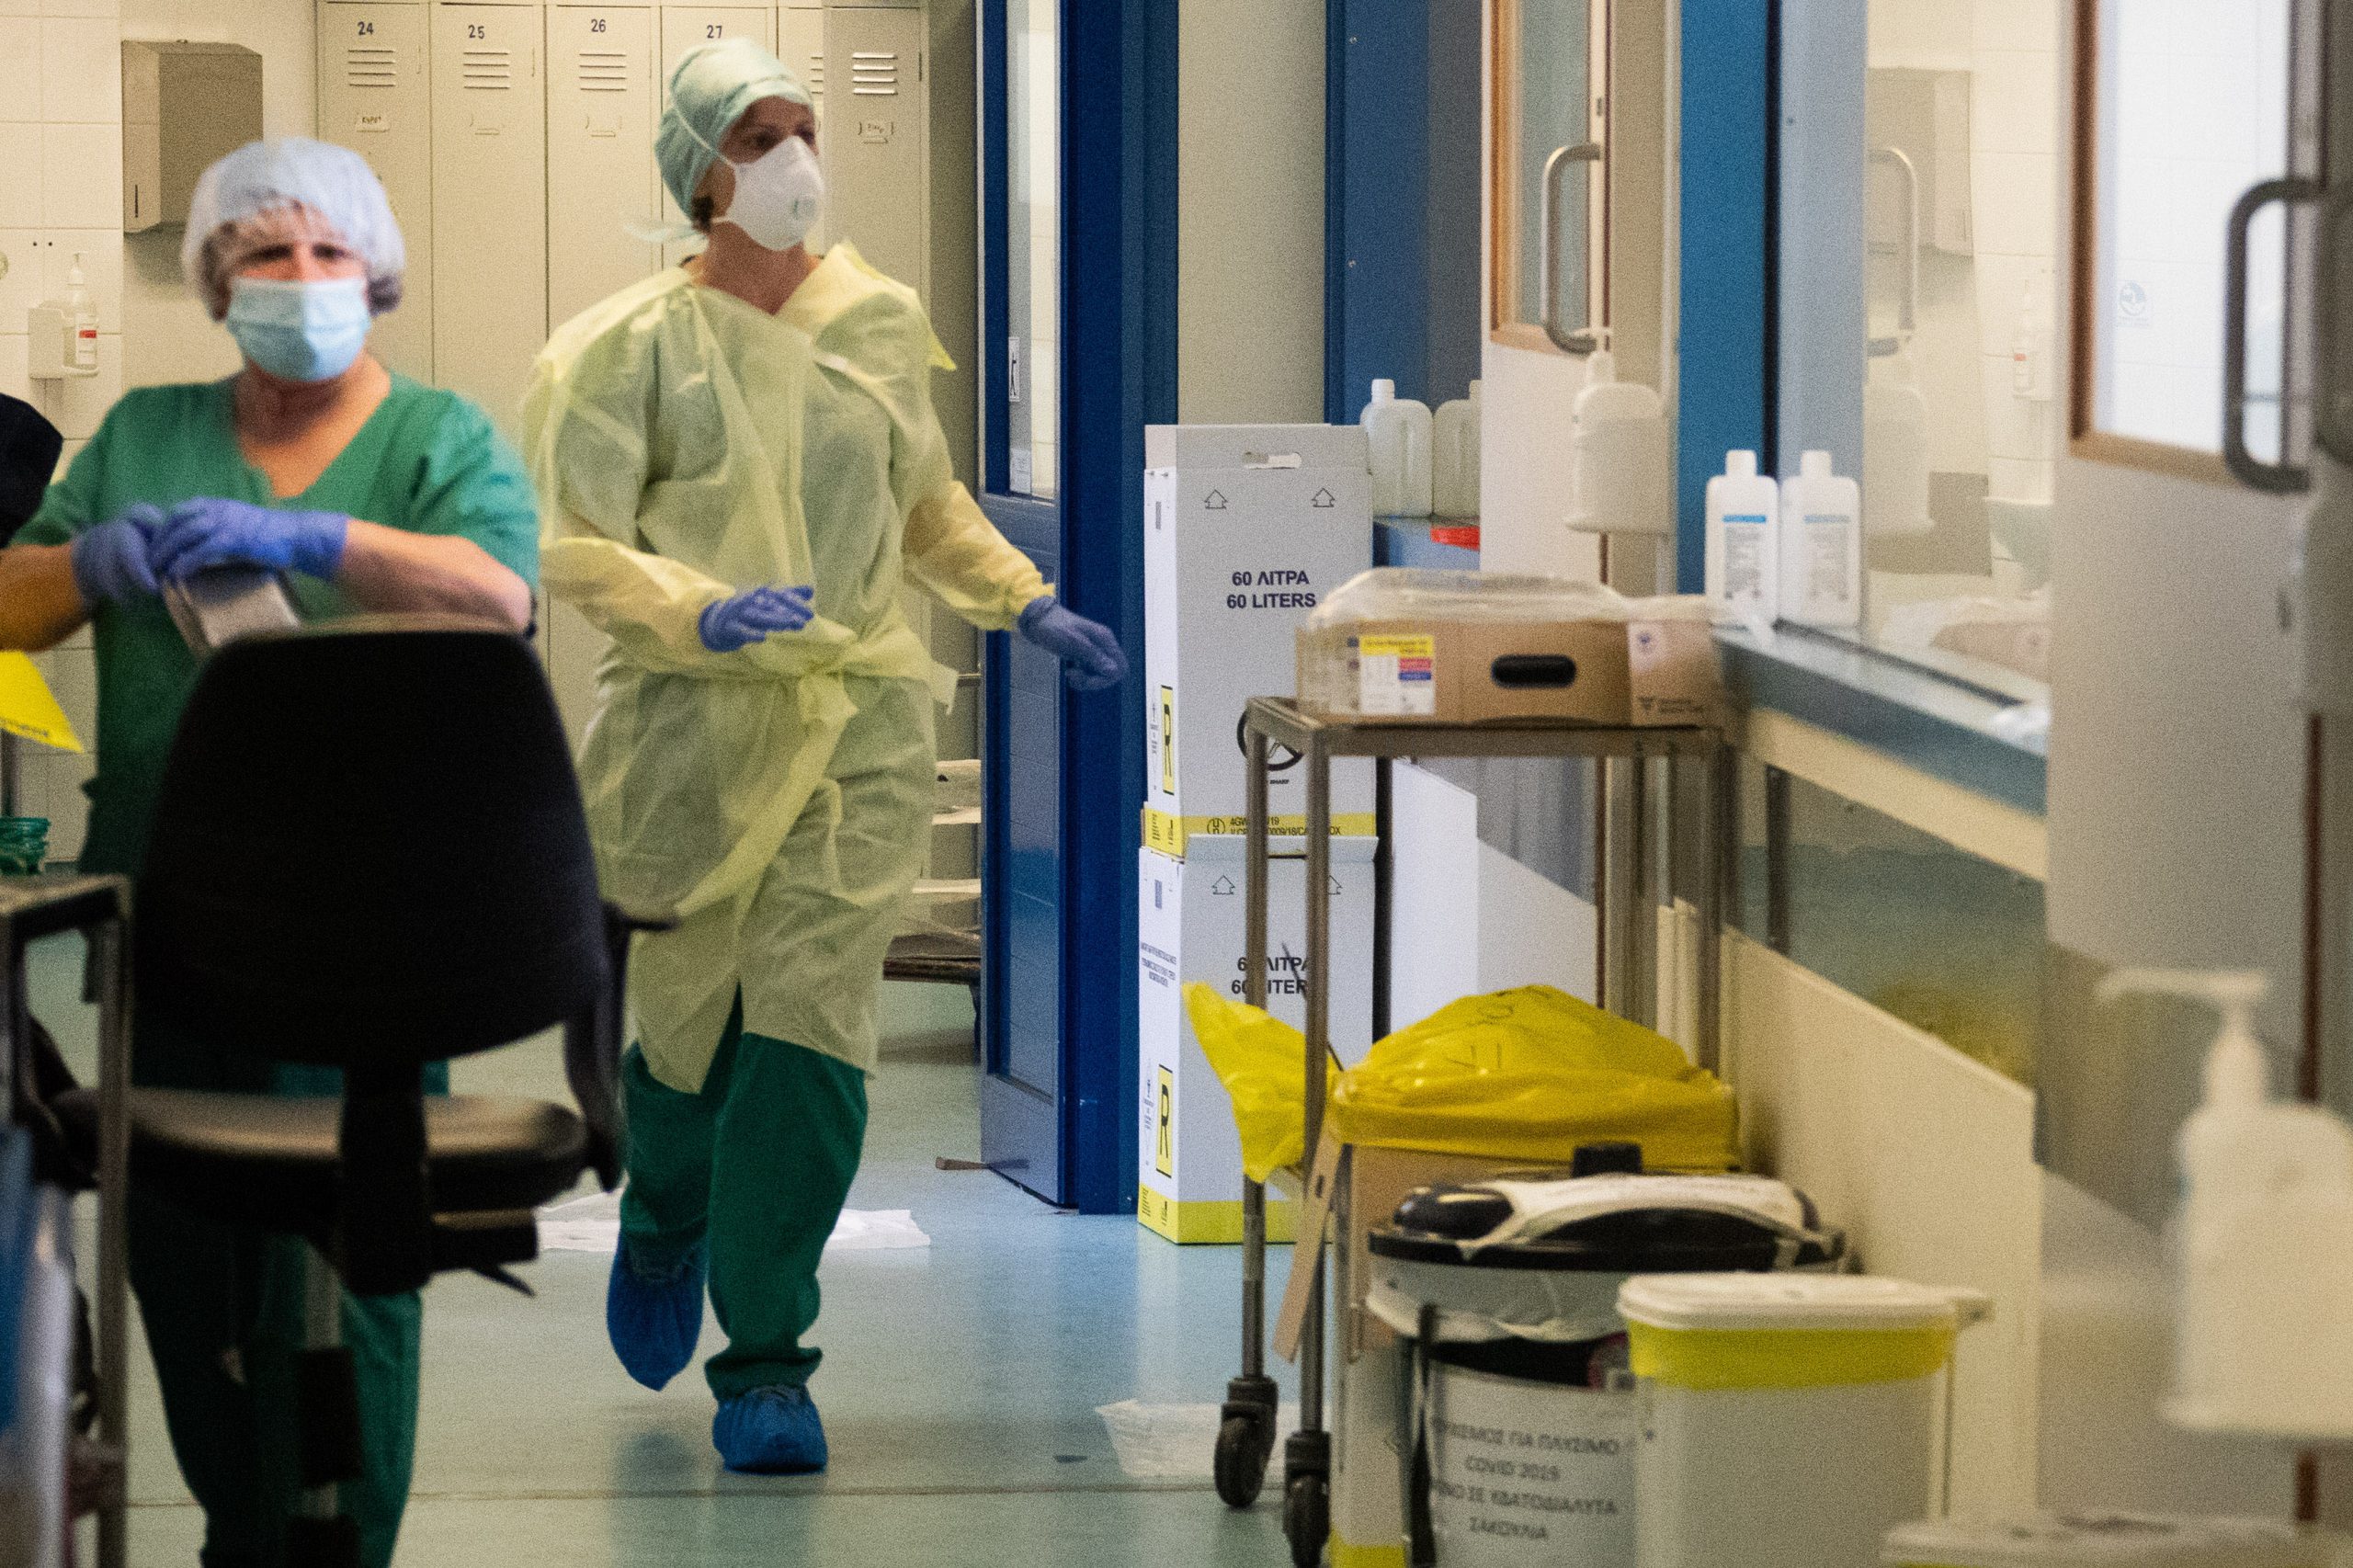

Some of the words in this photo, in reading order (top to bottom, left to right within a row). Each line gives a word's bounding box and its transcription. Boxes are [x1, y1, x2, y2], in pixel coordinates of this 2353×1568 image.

[357, 21, 374, 36] 24
[468, 25, 485, 40] 25
[590, 18, 607, 33] 26
[706, 25, 722, 39] 27
[1232, 571, 1252, 586] 60
[1257, 570, 1310, 585] ΛΙΤΡΑ
[1227, 594, 1247, 608] 60
[1252, 593, 1316, 608] LITERS
[1267, 980, 1308, 994] ITER
[1465, 1456, 1516, 1476] COVID
